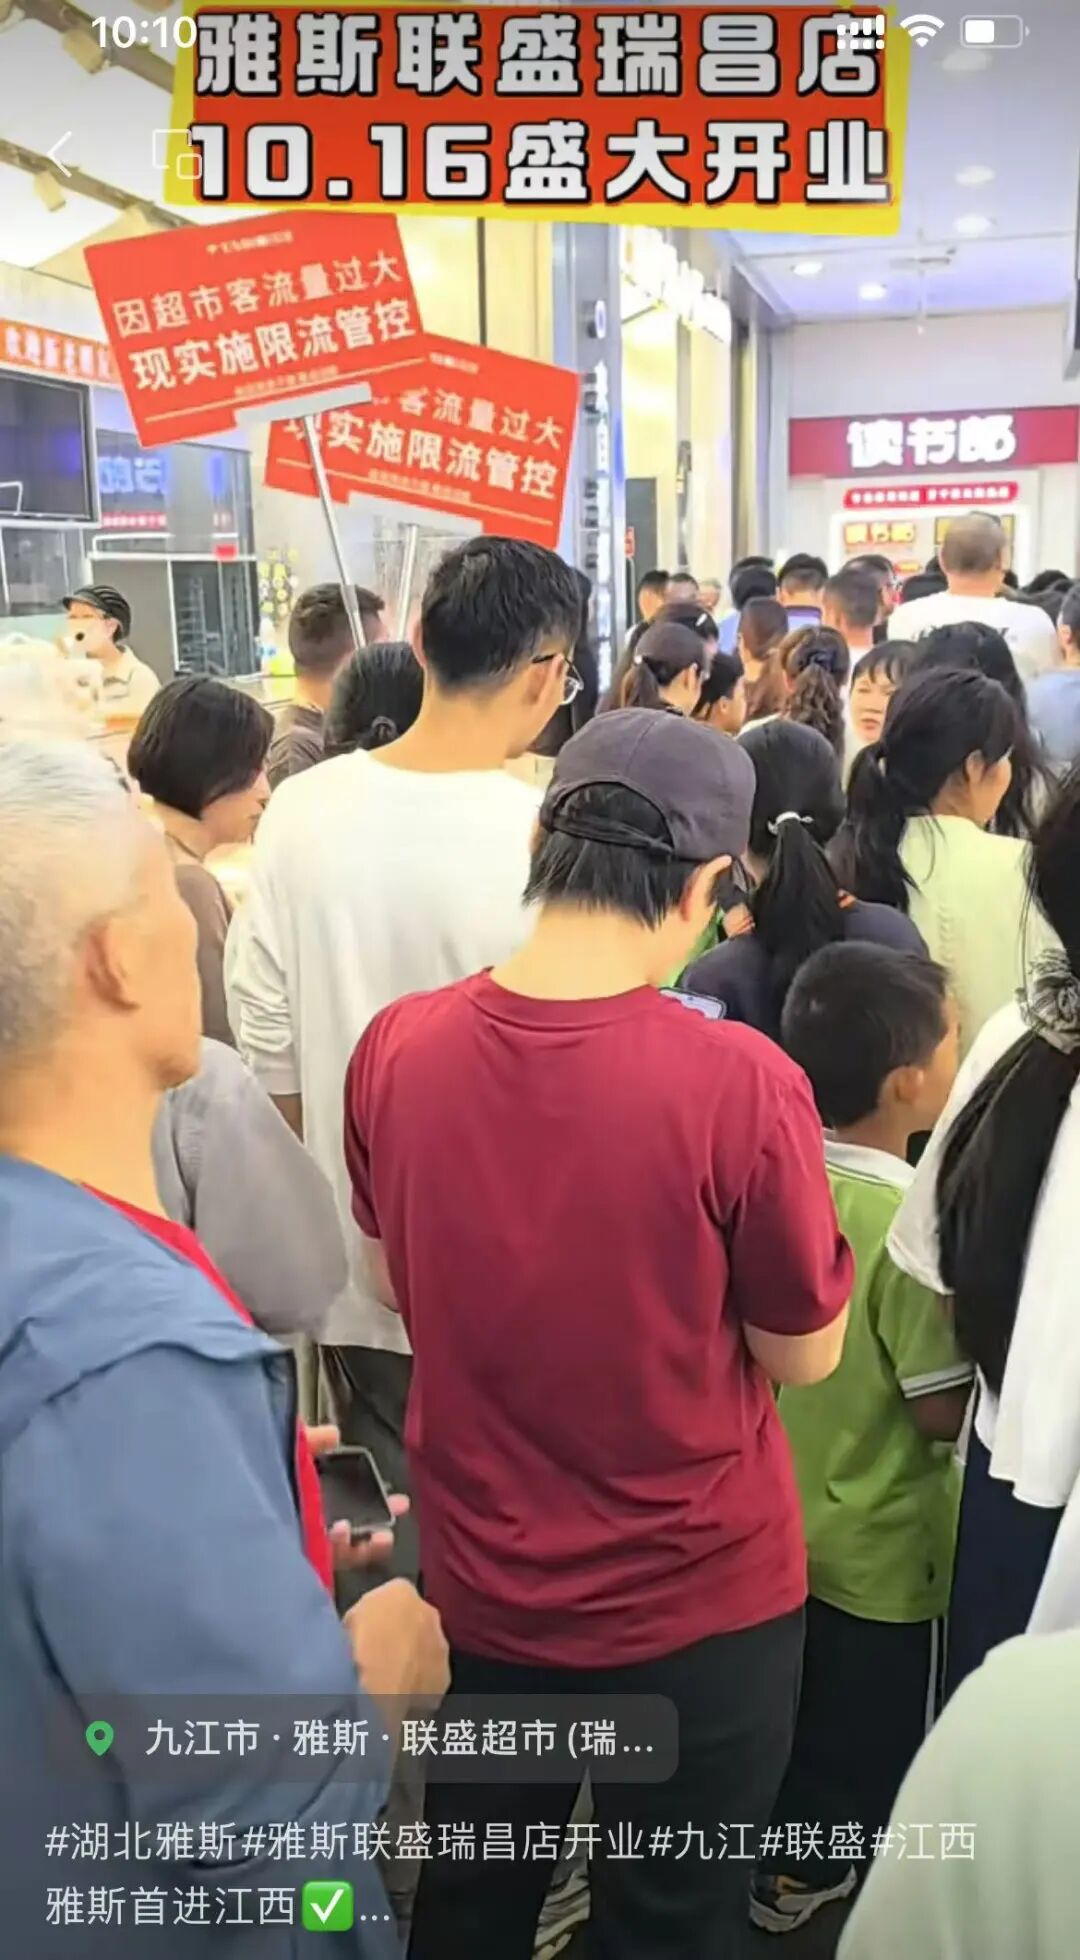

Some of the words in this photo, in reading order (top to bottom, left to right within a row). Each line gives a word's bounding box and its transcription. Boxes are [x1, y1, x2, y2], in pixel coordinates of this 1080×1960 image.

[111, 249, 403, 338] 因超市客流量过大
[128, 297, 416, 392] 现实施限流管控
